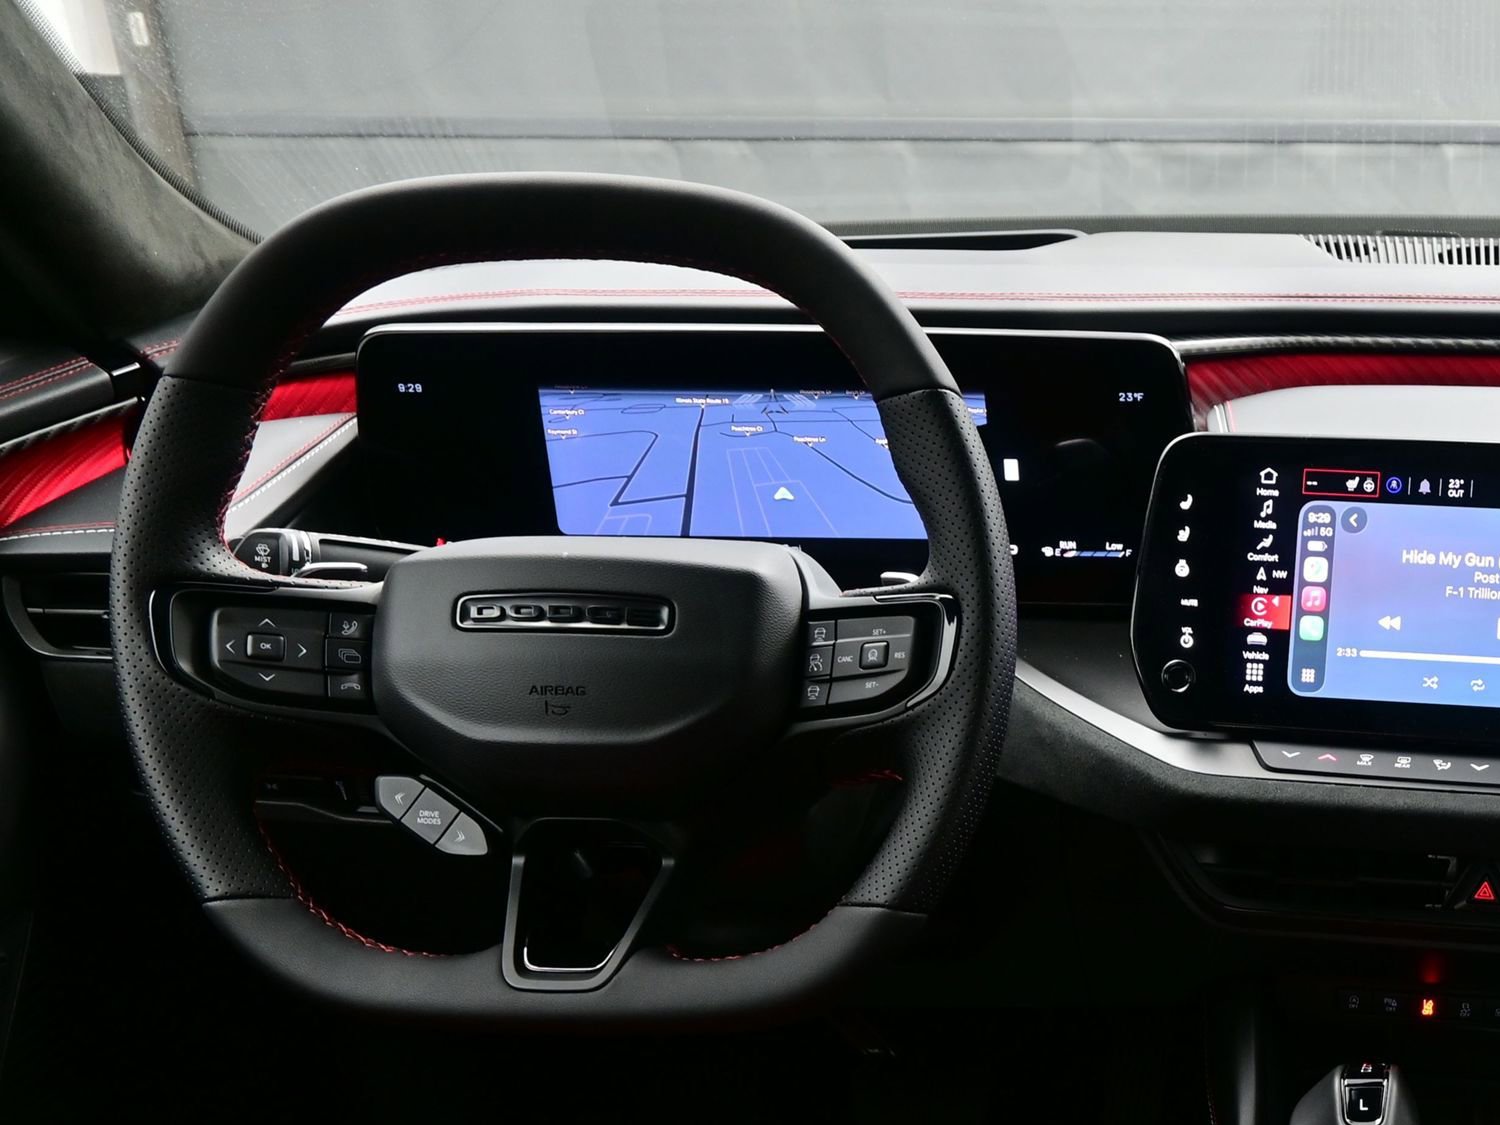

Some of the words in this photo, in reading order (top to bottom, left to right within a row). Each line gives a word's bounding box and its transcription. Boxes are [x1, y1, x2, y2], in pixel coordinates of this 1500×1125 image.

[397, 383, 423, 393] 9:29
[1119, 392, 1144, 402] 23°F
[1256, 487, 1279, 497] Home
[1447, 489, 1464, 498] OUT
[1308, 512, 1331, 523] 9:29
[1253, 520, 1277, 529] Media
[1319, 527, 1333, 536] 5G
[1059, 540, 1077, 549] RUN
[1125, 549, 1132, 557] F
[1247, 552, 1279, 562] Comfort
[254, 555, 272, 563] MIST
[1402, 549, 1436, 565] Hide
[1438, 551, 1461, 568] My
[1464, 552, 1495, 568] Gun
[1272, 569, 1288, 579] NW
[1473, 571, 1500, 584] Post
[1253, 585, 1269, 594] Nav
[1445, 586, 1464, 599] F-1
[469, 604, 663, 626] DODGE
[1243, 617, 1273, 629] CarPlay
[260, 642, 272, 650] OK
[894, 651, 905, 659] RES
[1242, 650, 1270, 661] Vehicle
[1336, 647, 1357, 657] 2:33
[529, 686, 586, 697] AIRBAG
[1243, 683, 1264, 694] Apps
[419, 810, 440, 818] DRIVE
[416, 817, 442, 826] MODES
[1359, 1099, 1369, 1111] L
